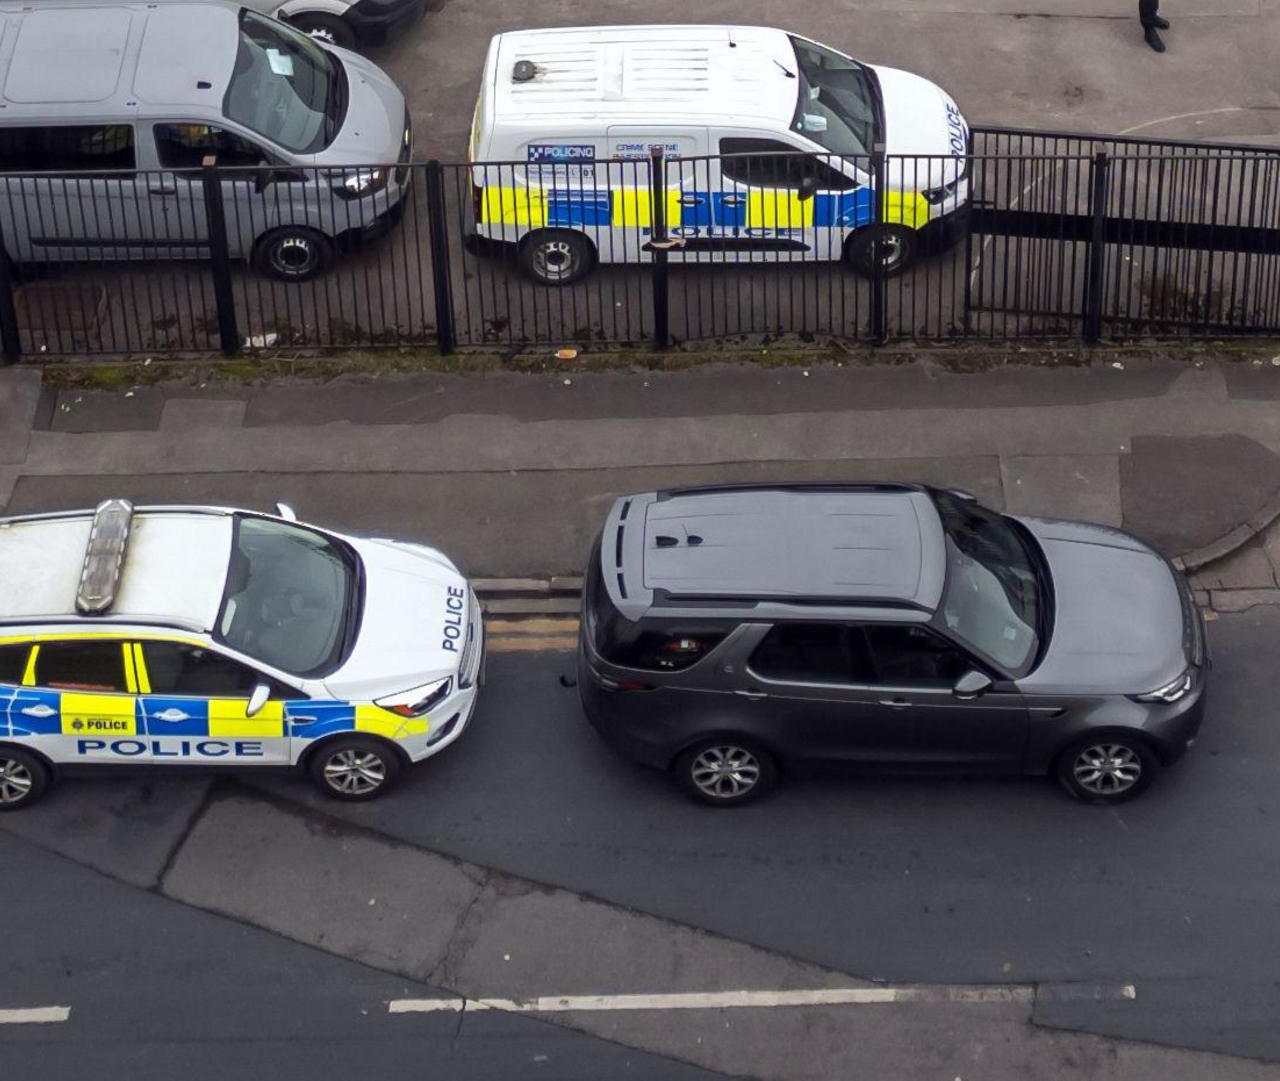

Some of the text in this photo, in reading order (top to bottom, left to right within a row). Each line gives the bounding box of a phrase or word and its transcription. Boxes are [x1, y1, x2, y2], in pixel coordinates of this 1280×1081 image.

[946, 103, 964, 163] POLICE
[544, 147, 594, 159] POLICING
[442, 586, 464, 653] POLICE
[87, 720, 128, 730] POLICE
[77, 739, 264, 756] POLICE
